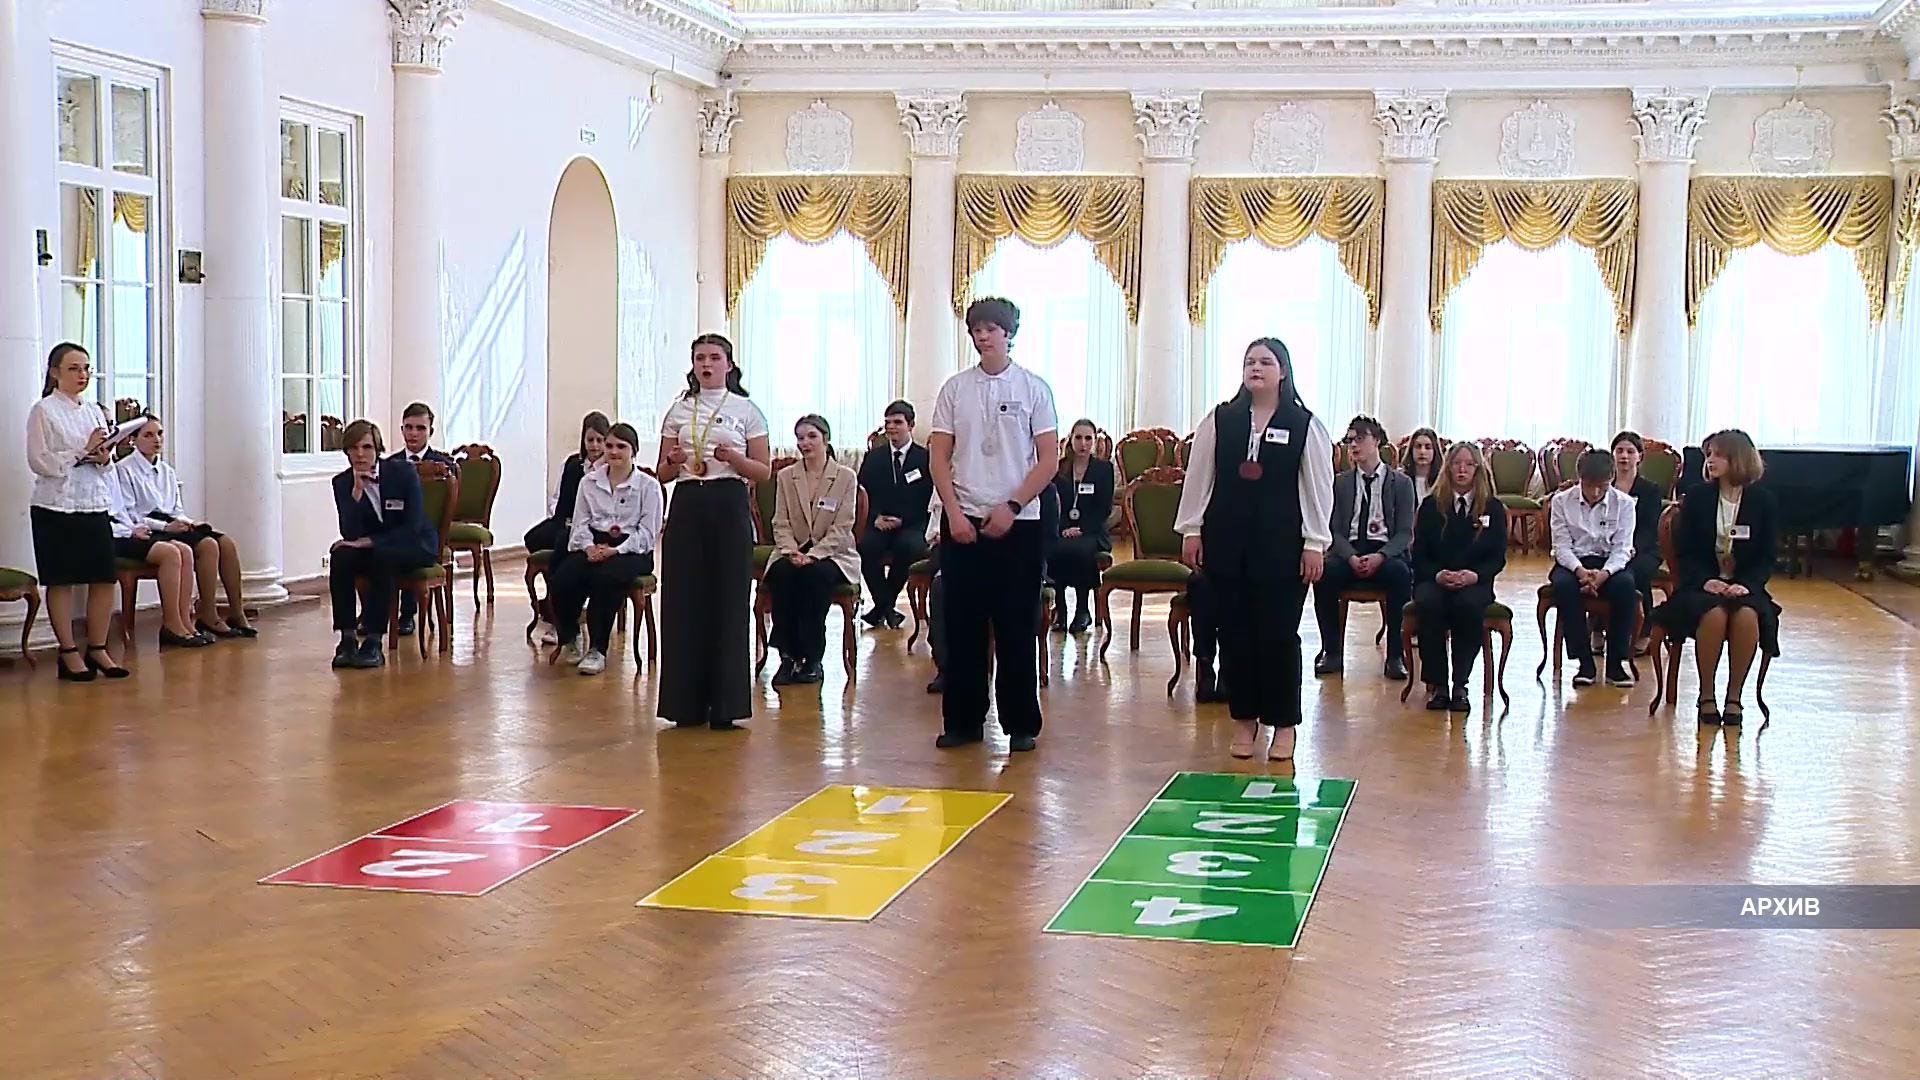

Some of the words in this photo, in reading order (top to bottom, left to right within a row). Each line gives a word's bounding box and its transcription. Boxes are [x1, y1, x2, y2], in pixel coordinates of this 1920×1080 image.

[861, 795, 929, 814] 1
[474, 812, 551, 832] 1
[1192, 811, 1286, 835] 2
[793, 829, 901, 855] 2
[360, 849, 488, 878] 2
[1165, 850, 1262, 878] 3
[730, 873, 838, 902] 3
[1131, 896, 1239, 926] 4
